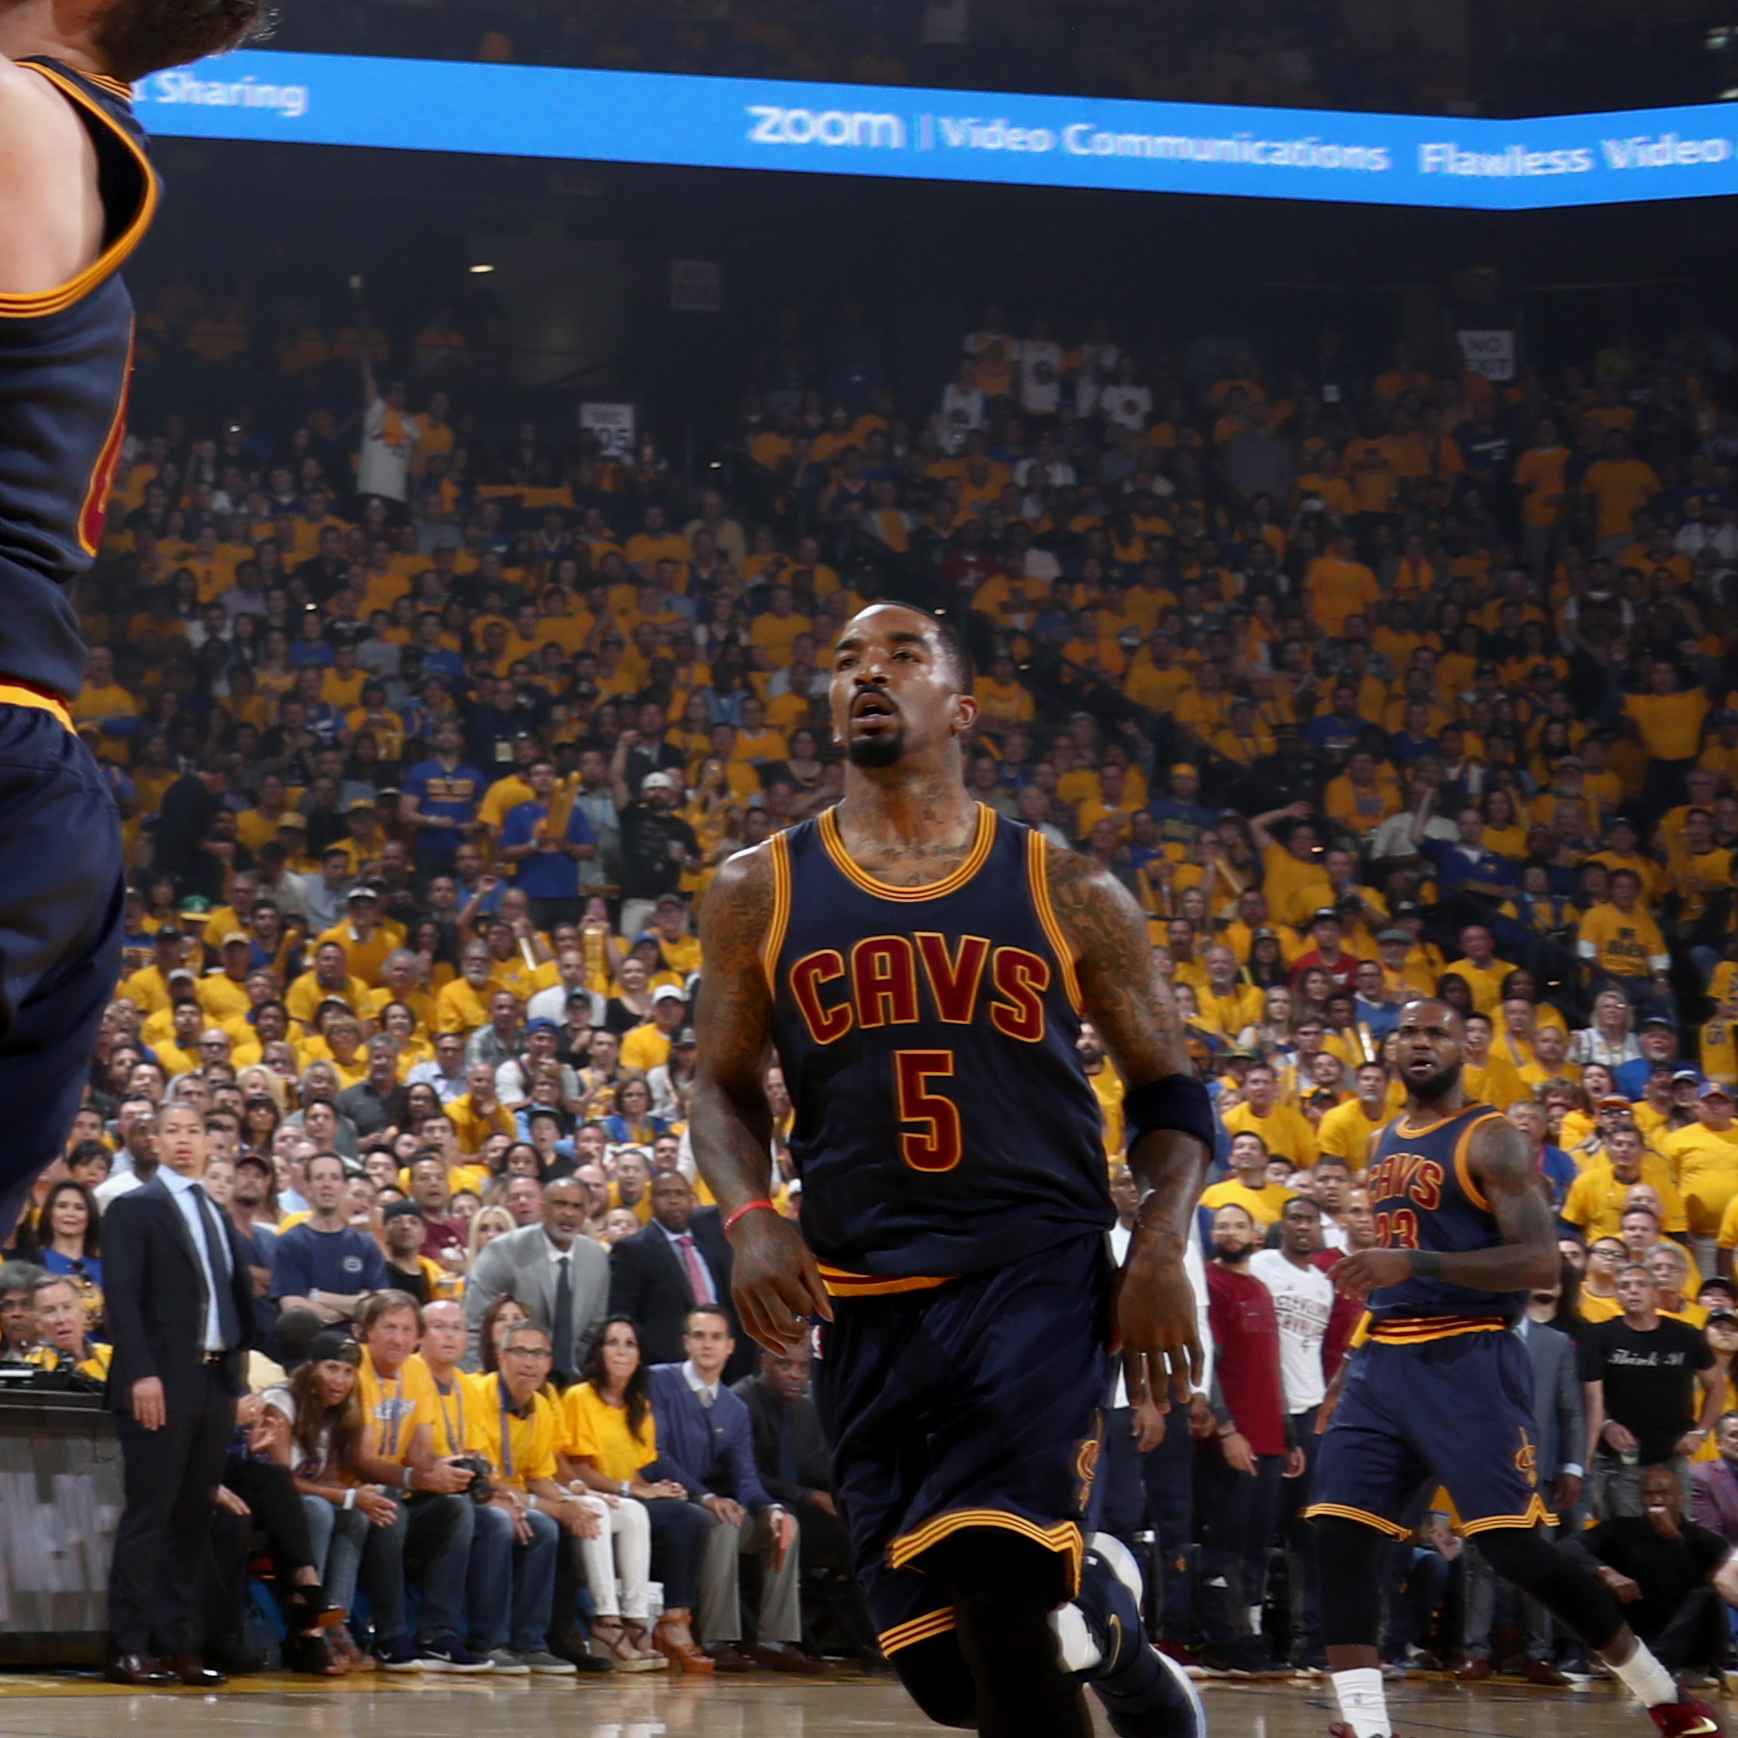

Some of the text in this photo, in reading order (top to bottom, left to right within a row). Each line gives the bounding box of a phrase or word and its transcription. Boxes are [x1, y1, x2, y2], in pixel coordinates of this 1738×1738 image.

[156, 72, 308, 117] Sharing
[746, 105, 1732, 178] zoom Video Communications Flawless Video
[789, 931, 1051, 1046] CAVS
[893, 1049, 963, 1173] 5
